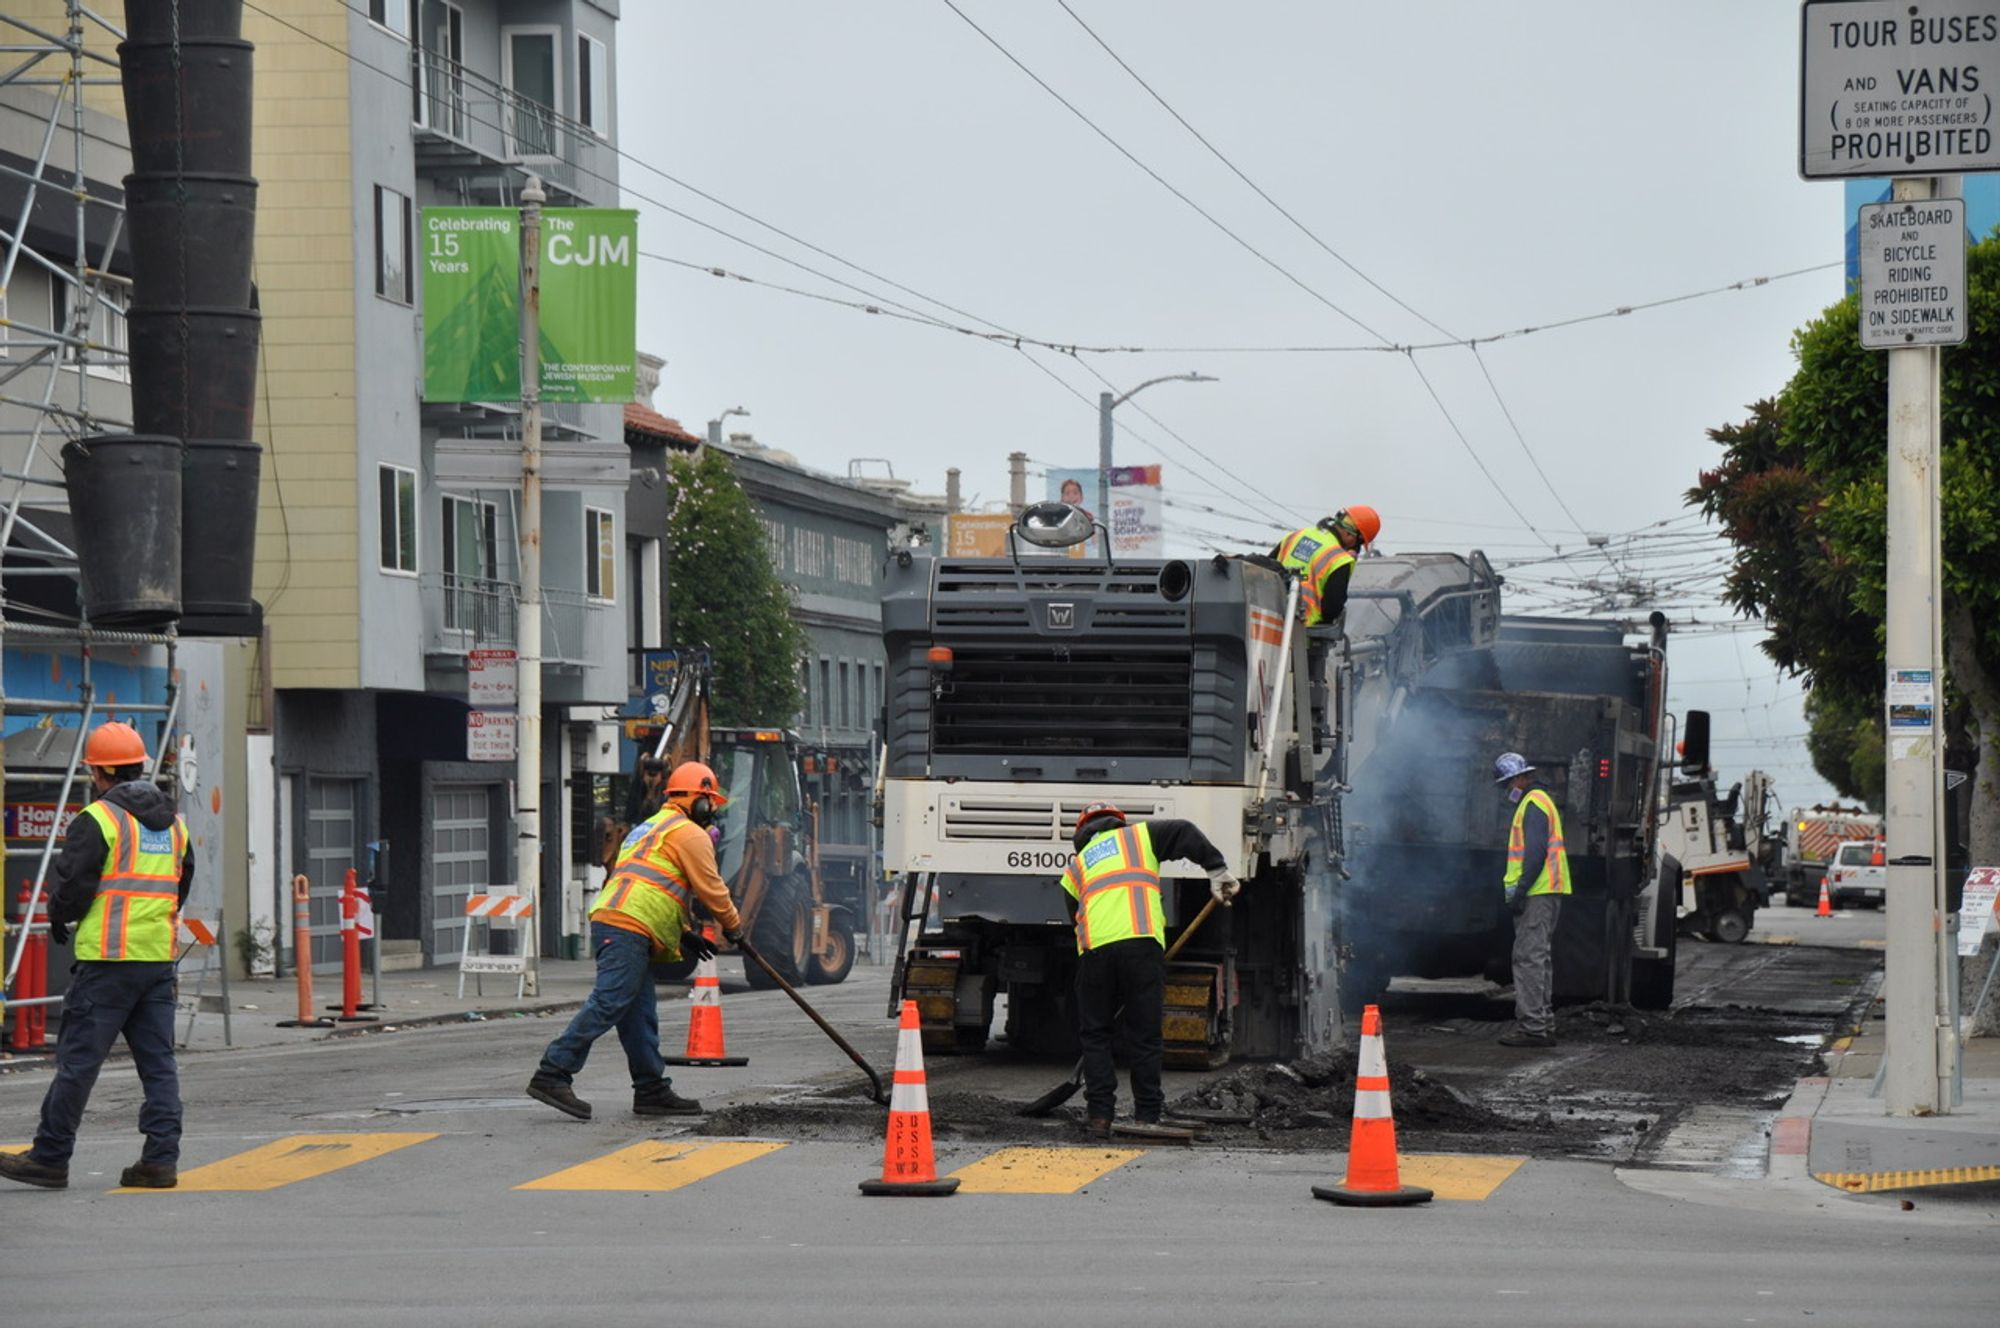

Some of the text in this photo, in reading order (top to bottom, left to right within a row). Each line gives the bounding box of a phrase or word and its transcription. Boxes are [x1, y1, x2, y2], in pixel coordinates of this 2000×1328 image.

[1830, 14, 1998, 49] TOUR BUSES
[1844, 65, 1980, 95] AND VANS
[1853, 97, 1970, 114] SEATING CAPACITY OF
[1845, 112, 1978, 129] 8 OR MORE PASSENGERS
[1831, 128, 1992, 160] PROHIBITED
[428, 217, 511, 234] Celebrating
[547, 217, 575, 231] The
[1870, 209, 1953, 229] SKATEBOARD
[1901, 231, 1919, 241] AND
[430, 233, 460, 257] 15
[547, 235, 630, 267] CJM
[1883, 245, 1937, 263] BICYCLE
[430, 259, 469, 273] Years
[1888, 266, 1932, 283] RIDING
[1874, 286, 1949, 305] PROHIBITED
[1869, 306, 1955, 327] ON SIDEWALK
[543, 363, 631, 373] THE CONTEMPORARY
[542, 372, 615, 382] JEWISH MUSEUM
[956, 530, 976, 546] 15
[469, 712, 483, 727] NO
